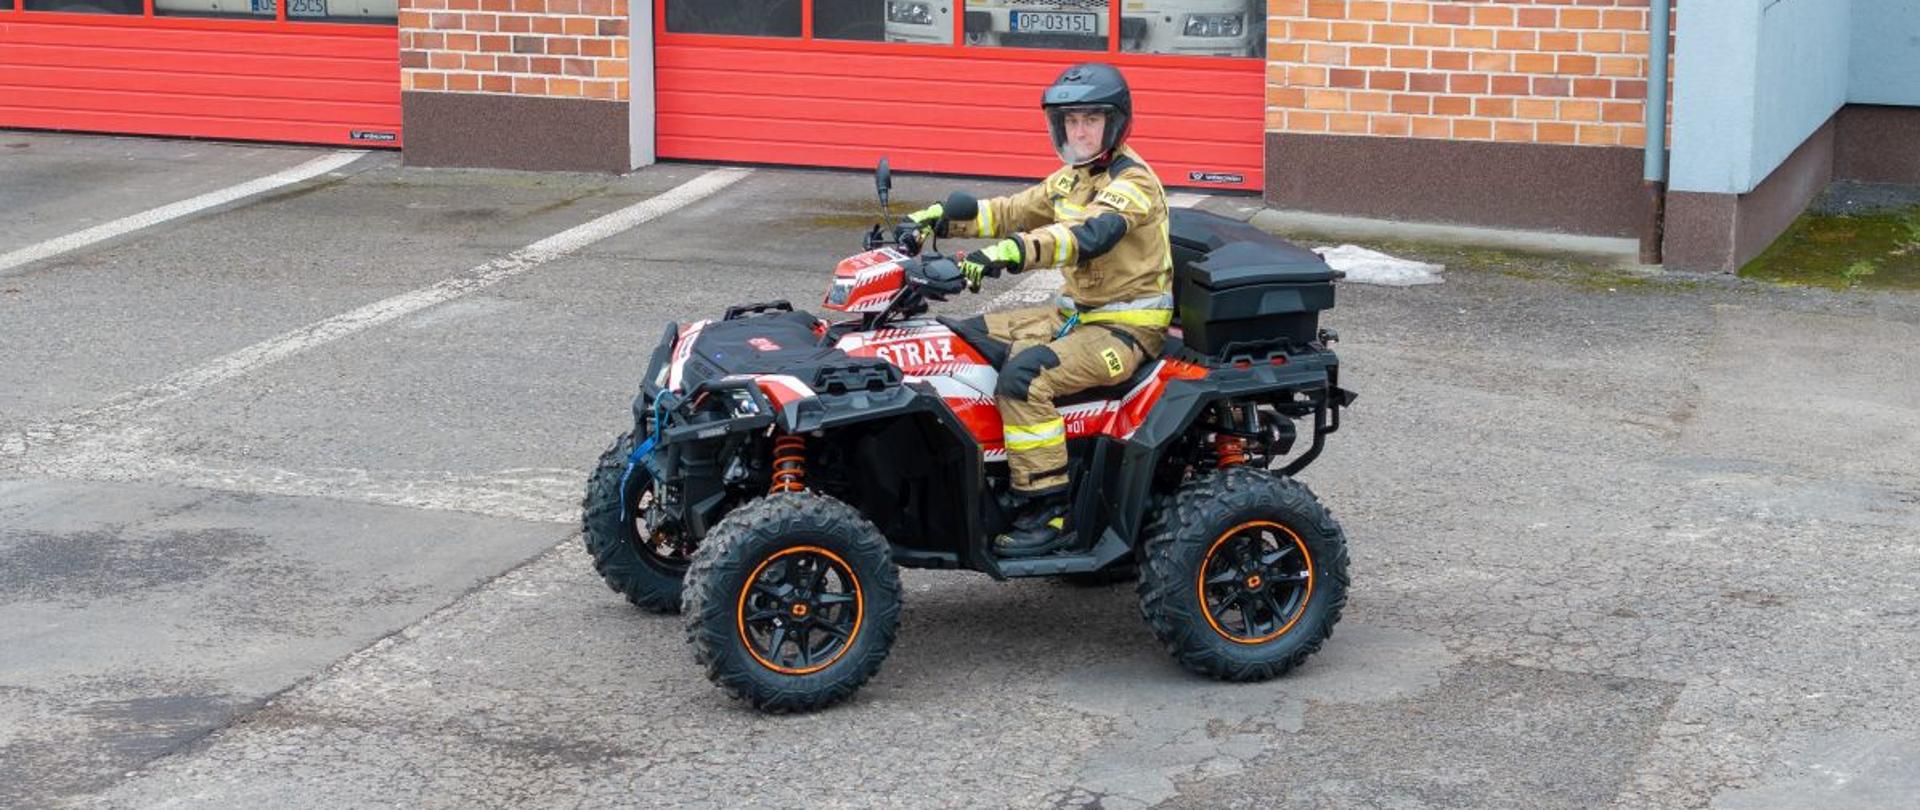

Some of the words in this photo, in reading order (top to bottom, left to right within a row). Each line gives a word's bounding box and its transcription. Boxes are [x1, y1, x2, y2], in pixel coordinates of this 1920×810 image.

[1020, 14, 1039, 29] OP
[1046, 15, 1091, 31] 0315L
[1103, 191, 1125, 205] PSP
[1105, 351, 1121, 371] PSP
